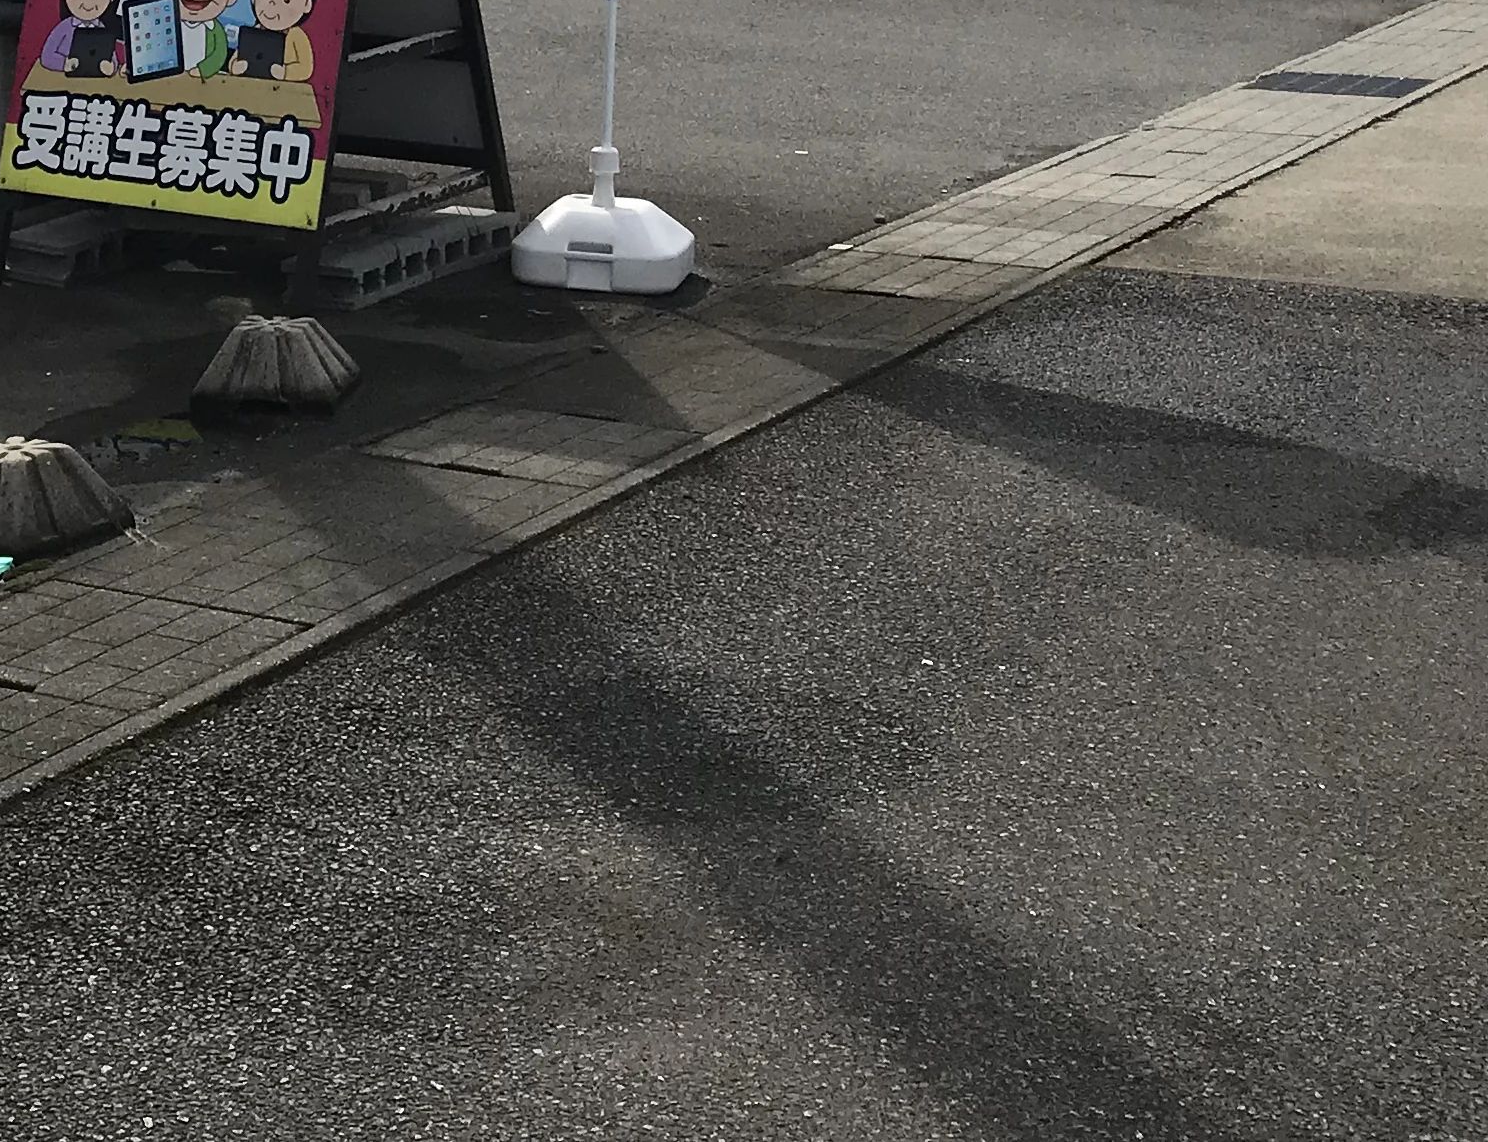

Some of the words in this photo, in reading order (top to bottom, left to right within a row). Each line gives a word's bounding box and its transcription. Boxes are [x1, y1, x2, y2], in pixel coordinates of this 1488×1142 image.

[15, 93, 312, 201] 受講生募集中
